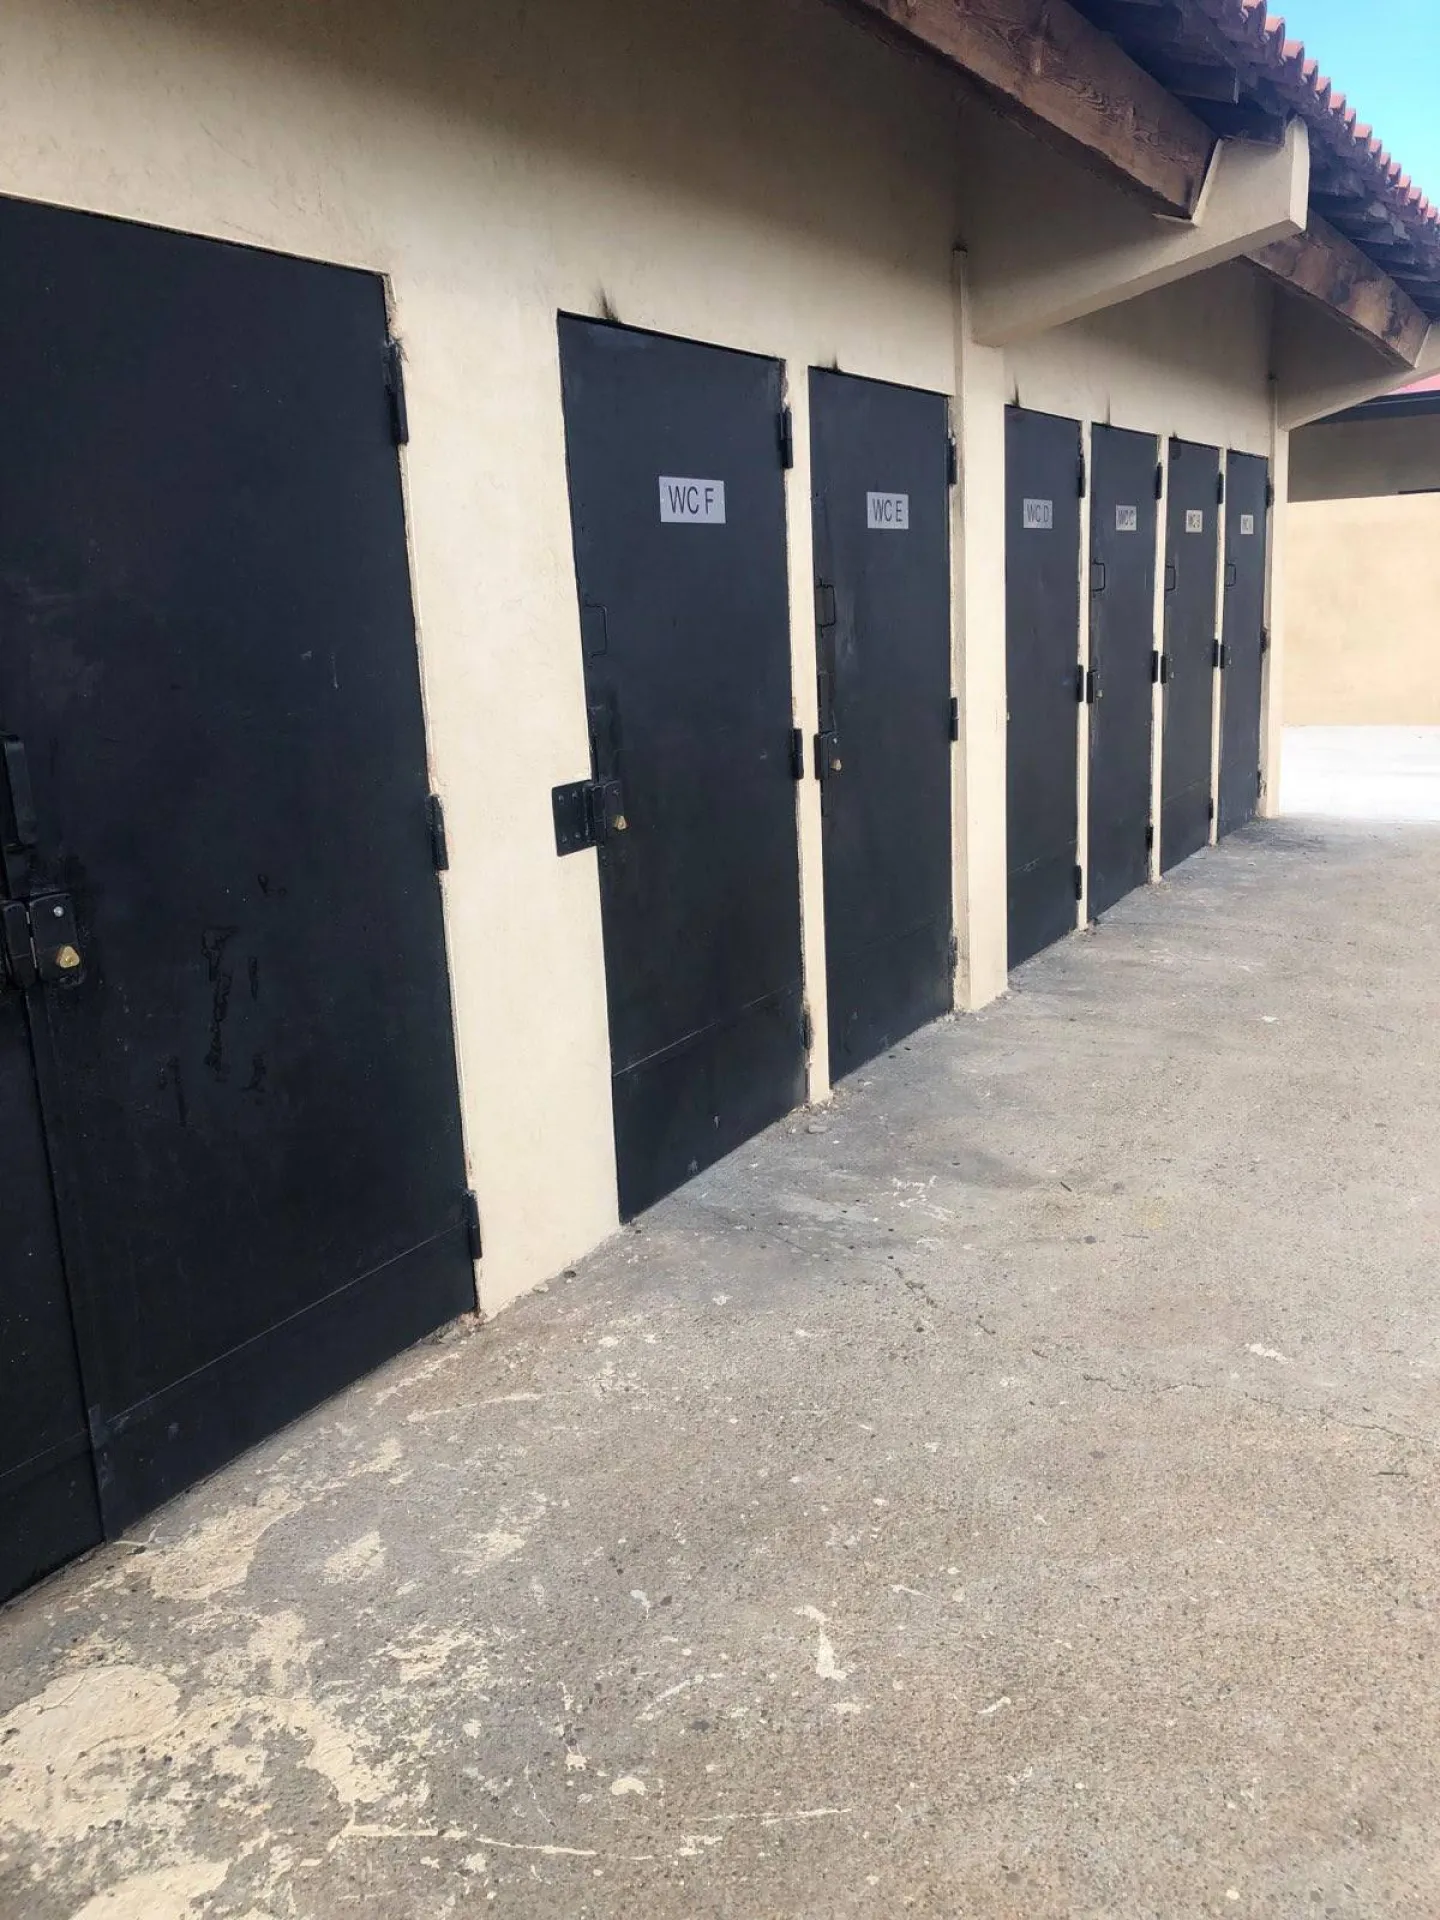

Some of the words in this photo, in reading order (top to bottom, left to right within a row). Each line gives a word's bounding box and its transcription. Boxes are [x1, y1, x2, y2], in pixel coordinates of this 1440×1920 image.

[668, 485, 700, 515] WC
[705, 487, 714, 515] F
[872, 499, 893, 522] WC
[896, 500, 903, 522] E
[1026, 503, 1041, 523] WC
